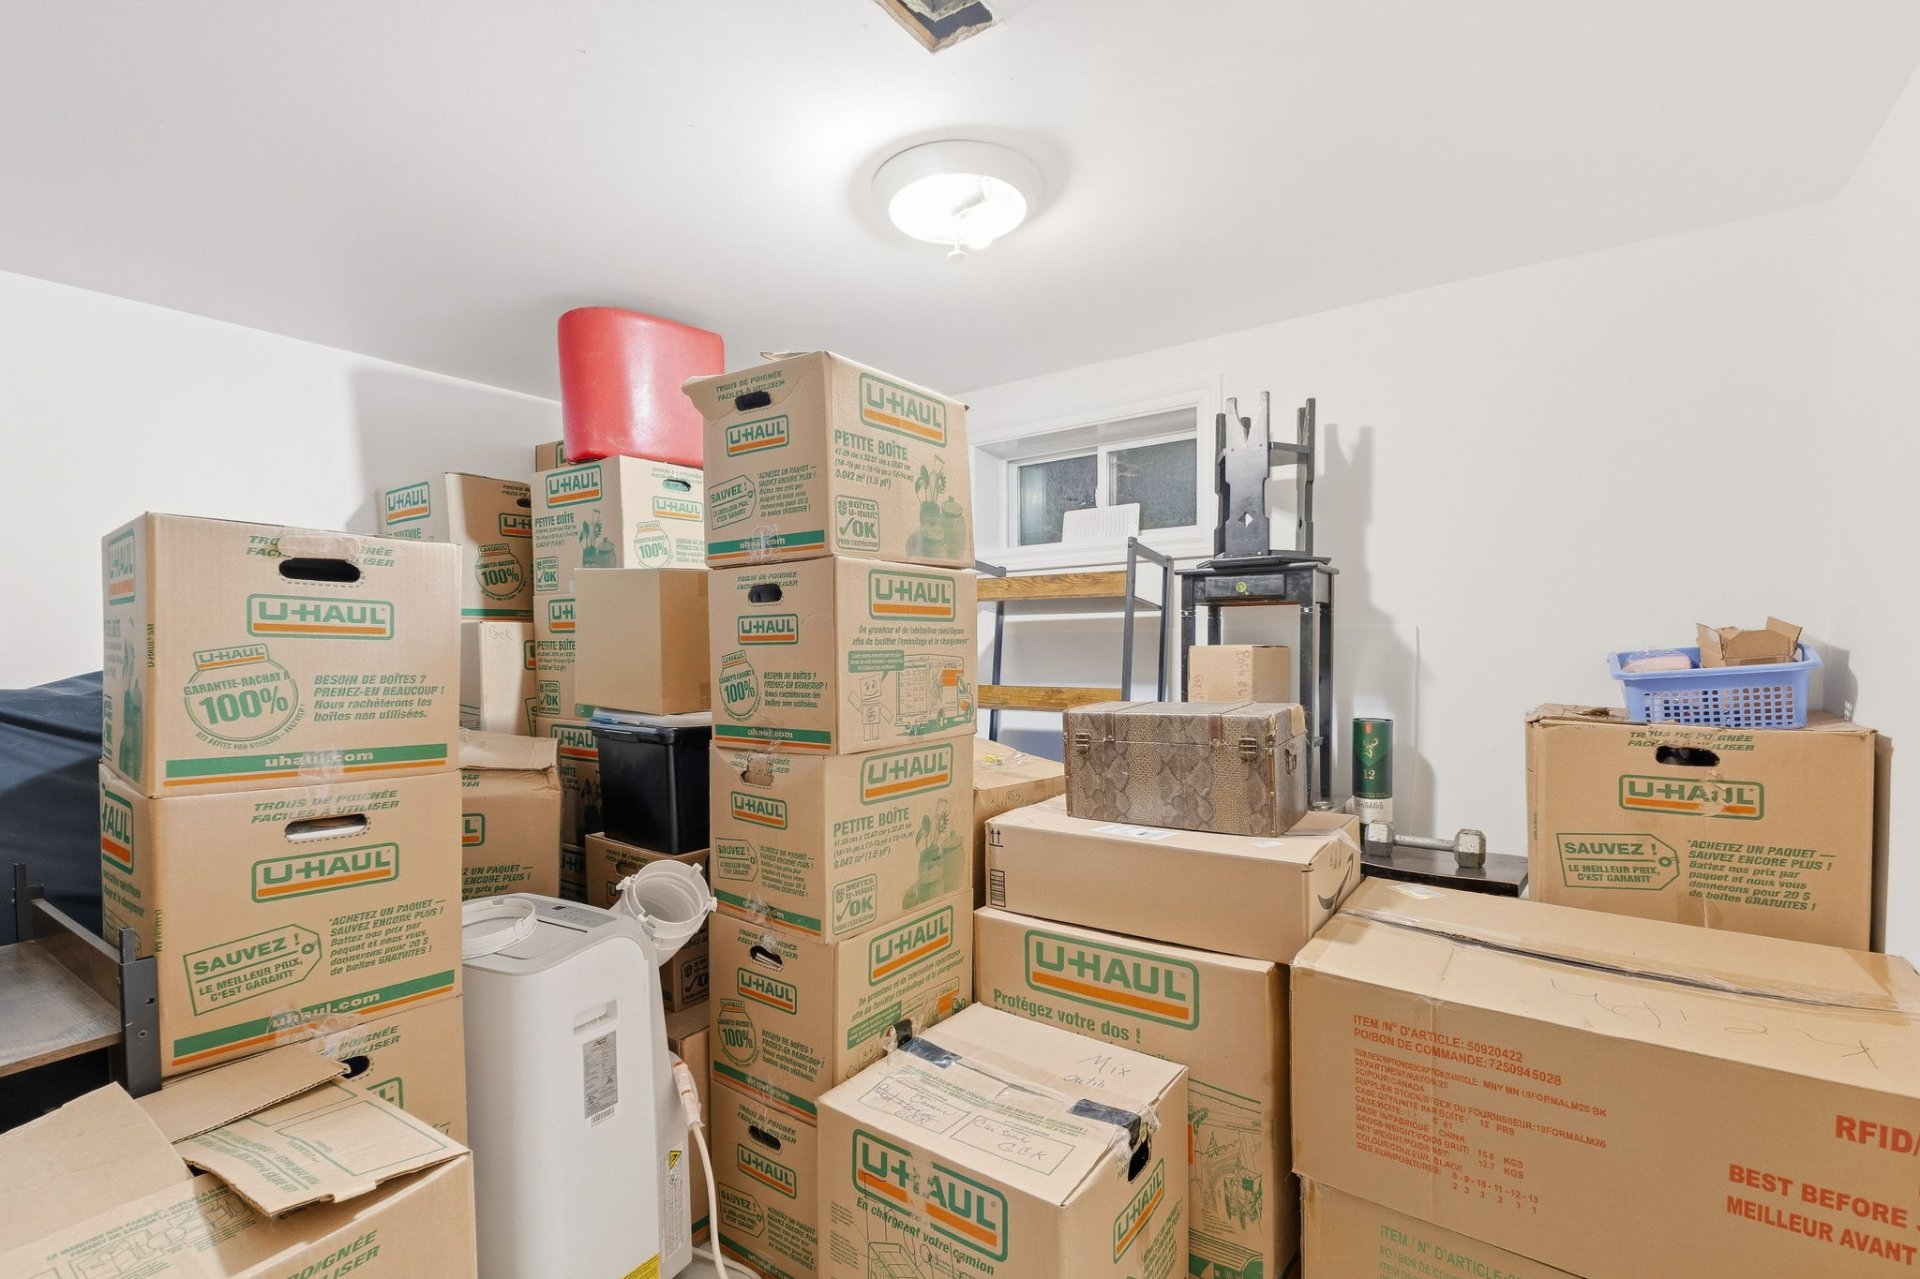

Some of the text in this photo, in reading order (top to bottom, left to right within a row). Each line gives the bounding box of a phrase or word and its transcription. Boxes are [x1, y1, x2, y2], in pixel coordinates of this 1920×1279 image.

[867, 384, 942, 428] U-HAUL
[730, 421, 784, 444] U-HAUL
[835, 430, 874, 452] PETITE
[550, 472, 598, 494] U-HAUL
[388, 489, 427, 512] U-HAUL
[852, 520, 876, 538] OK
[482, 568, 519, 586] 100%
[875, 578, 950, 604] U-HAUL
[259, 602, 385, 624] U-HAUL
[741, 618, 794, 633] U-HAUL
[199, 647, 265, 662] U-HAUL
[314, 675, 358, 685] BESOIN
[361, 675, 376, 684] DE
[724, 680, 755, 704] 100%
[199, 686, 288, 724] 100%
[868, 752, 947, 784] U-HAUL
[1364, 769, 1376, 780] 12
[734, 797, 783, 818] U-HAUL
[834, 807, 910, 837] PETITE BOÎTE
[1565, 842, 1644, 856] SAUVEZ
[1747, 845, 1817, 858] UN PAQUET
[264, 851, 390, 884] U-HAUL
[472, 864, 520, 875] UN PAQUET
[1569, 864, 1579, 872] LE
[1688, 850, 1823, 870] SAUVEZ ENCORE PLUS
[1690, 860, 1800, 879] Battez nos prix par
[1689, 872, 1728, 880] paquet
[1747, 878, 1775, 886] nous
[1779, 881, 1807, 889] vous
[1689, 880, 1799, 899] donnerons pour 20
[850, 895, 874, 916] OK
[1689, 890, 1703, 898] de
[1745, 896, 1808, 910] GRATUITES
[331, 922, 371, 936] SAUVEZ
[876, 916, 948, 964] U-HAUL
[194, 937, 287, 976] SAUVEZ
[200, 984, 214, 996] LE
[217, 967, 271, 990] MEILLEUR
[1036, 941, 1185, 1001] U-HAUL
[741, 974, 792, 1002] U-HAUL
[993, 988, 1129, 1040] Protégez votre dos
[1353, 1014, 1378, 1030] ITEM
[722, 1028, 753, 1049] 100%
[1354, 1028, 1394, 1046] PO/BON
[1398, 1039, 1413, 1050] DE
[1592, 1106, 1608, 1118] BK
[1439, 1129, 1466, 1142] CHINA
[740, 1154, 792, 1186] U-HAUL
[1434, 1157, 1462, 1171] BLACK
[1504, 1156, 1524, 1169] KGS
[1118, 1172, 1162, 1241] U-HAUL
[1729, 1164, 1907, 1229] BEST BEFORE
[856, 1197, 994, 1276] En chargeant votre camion
[1381, 1225, 1408, 1246] ITEM
[1726, 1196, 1918, 1266] MEILLEUR AVANT
